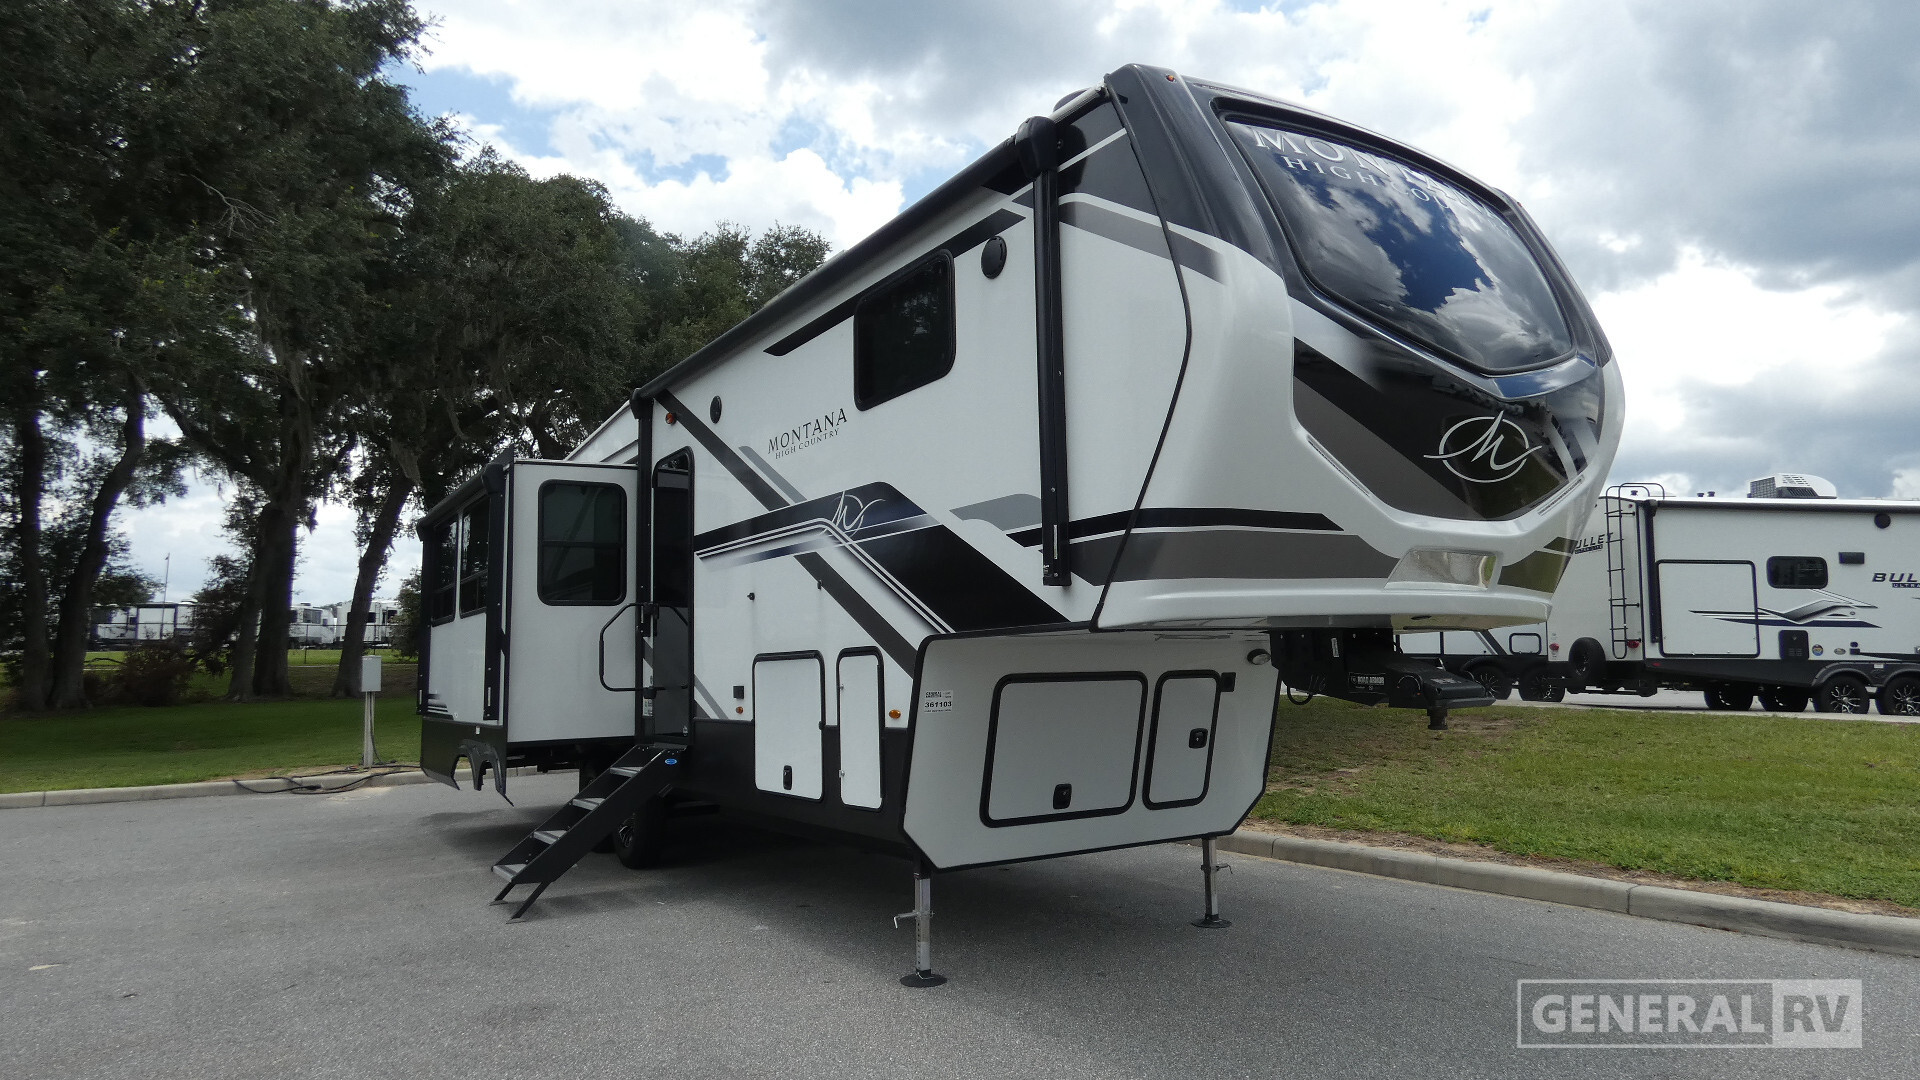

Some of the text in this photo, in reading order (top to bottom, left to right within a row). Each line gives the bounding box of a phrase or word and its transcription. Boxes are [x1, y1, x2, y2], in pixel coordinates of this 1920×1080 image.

[1281, 156, 1380, 187] HIGH
[768, 408, 848, 454] MONTANA
[775, 427, 840, 460] HIGH COUNTRY
[1575, 532, 1614, 549] ULLET
